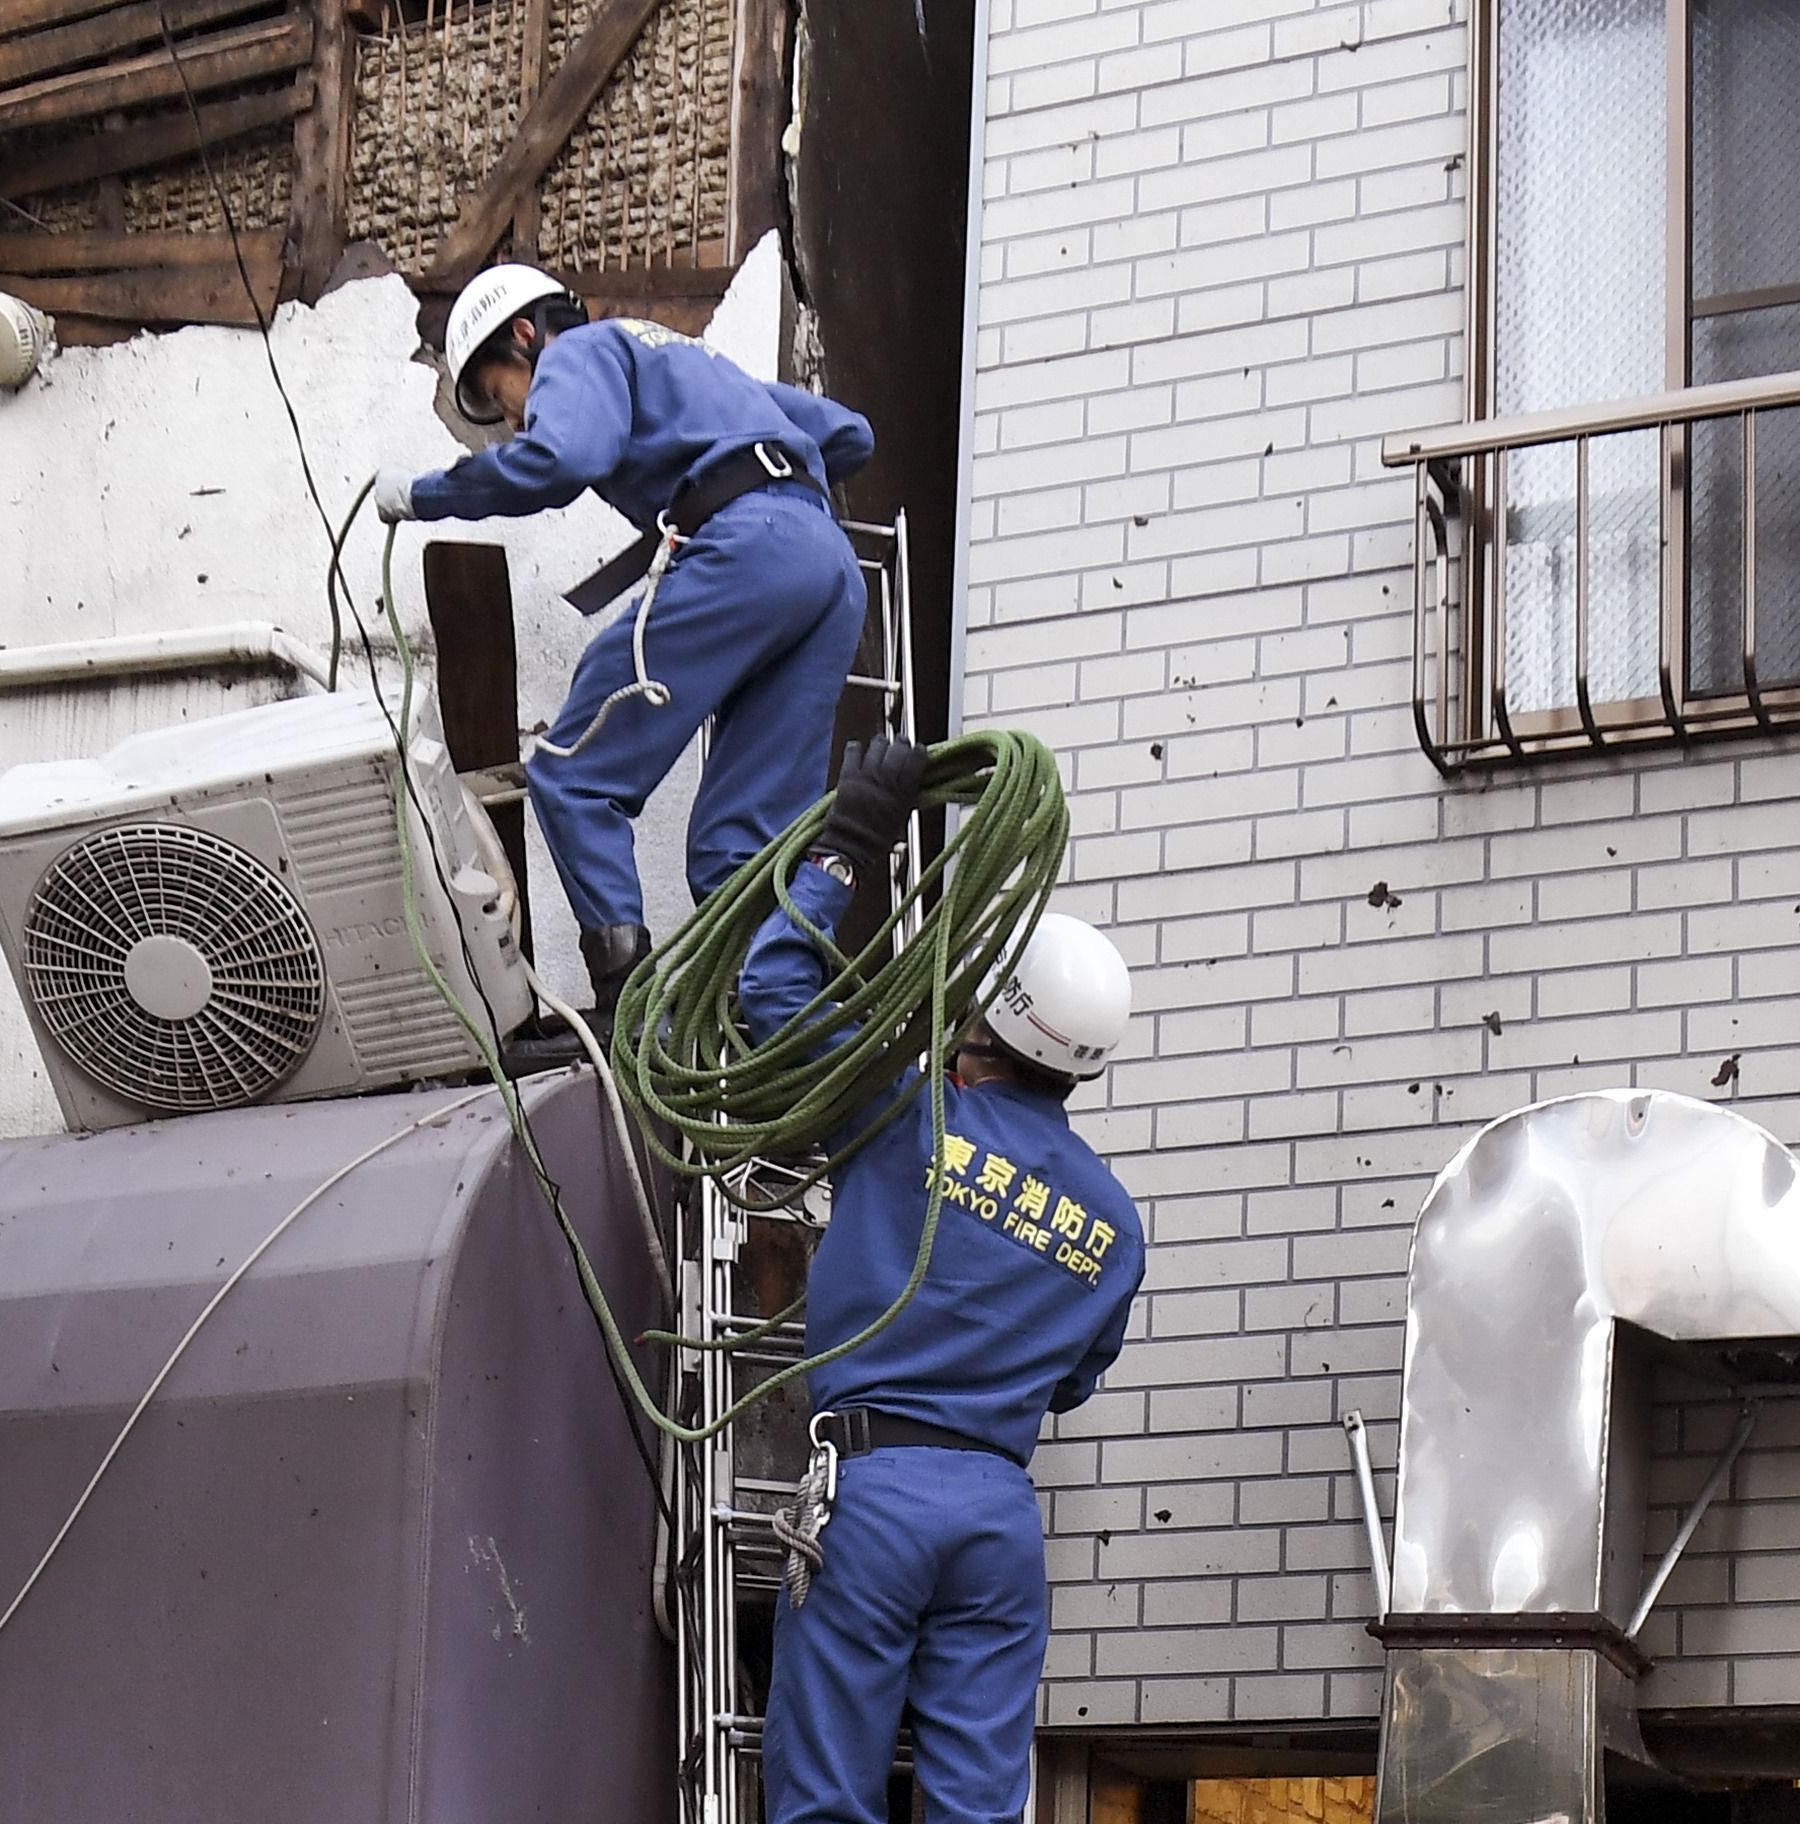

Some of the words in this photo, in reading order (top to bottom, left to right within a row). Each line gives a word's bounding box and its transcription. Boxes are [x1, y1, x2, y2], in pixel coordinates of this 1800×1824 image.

[931, 1133, 1116, 1259] 東京消防庁
[1003, 1211, 1053, 1252] FIRE
[1055, 1242, 1103, 1287] DEPT.
